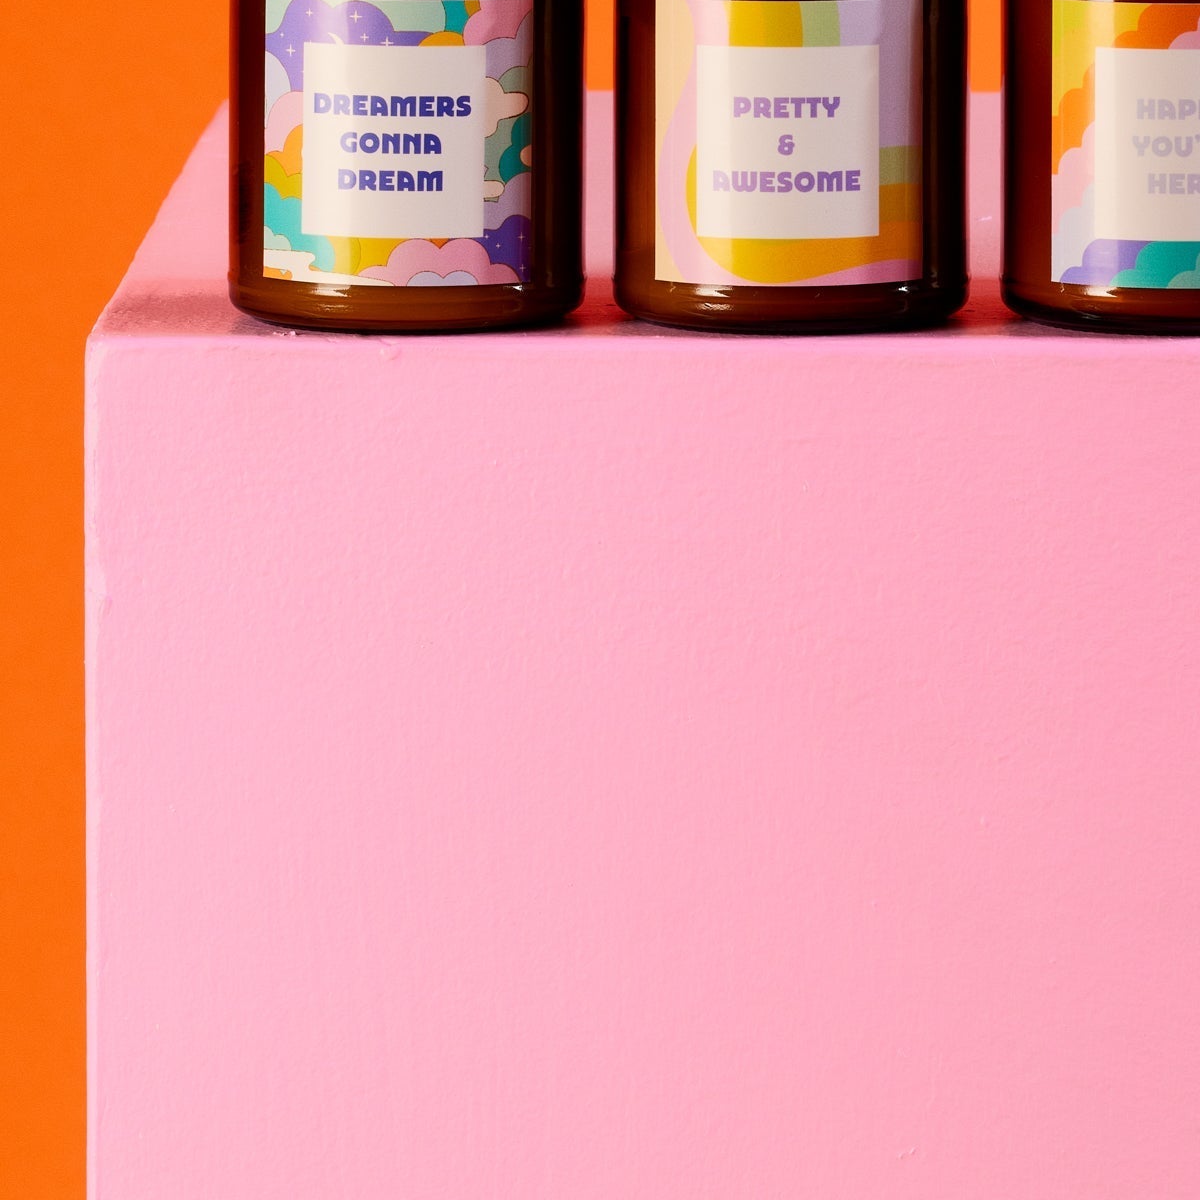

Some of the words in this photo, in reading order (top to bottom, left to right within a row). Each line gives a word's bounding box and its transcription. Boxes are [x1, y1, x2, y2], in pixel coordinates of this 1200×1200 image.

[314, 93, 472, 117] DREAMERS
[733, 96, 841, 118] PRETTY
[340, 131, 442, 154] GONNA
[777, 134, 795, 156] &
[338, 169, 443, 192] DREAM
[712, 170, 861, 193] AWESOME
